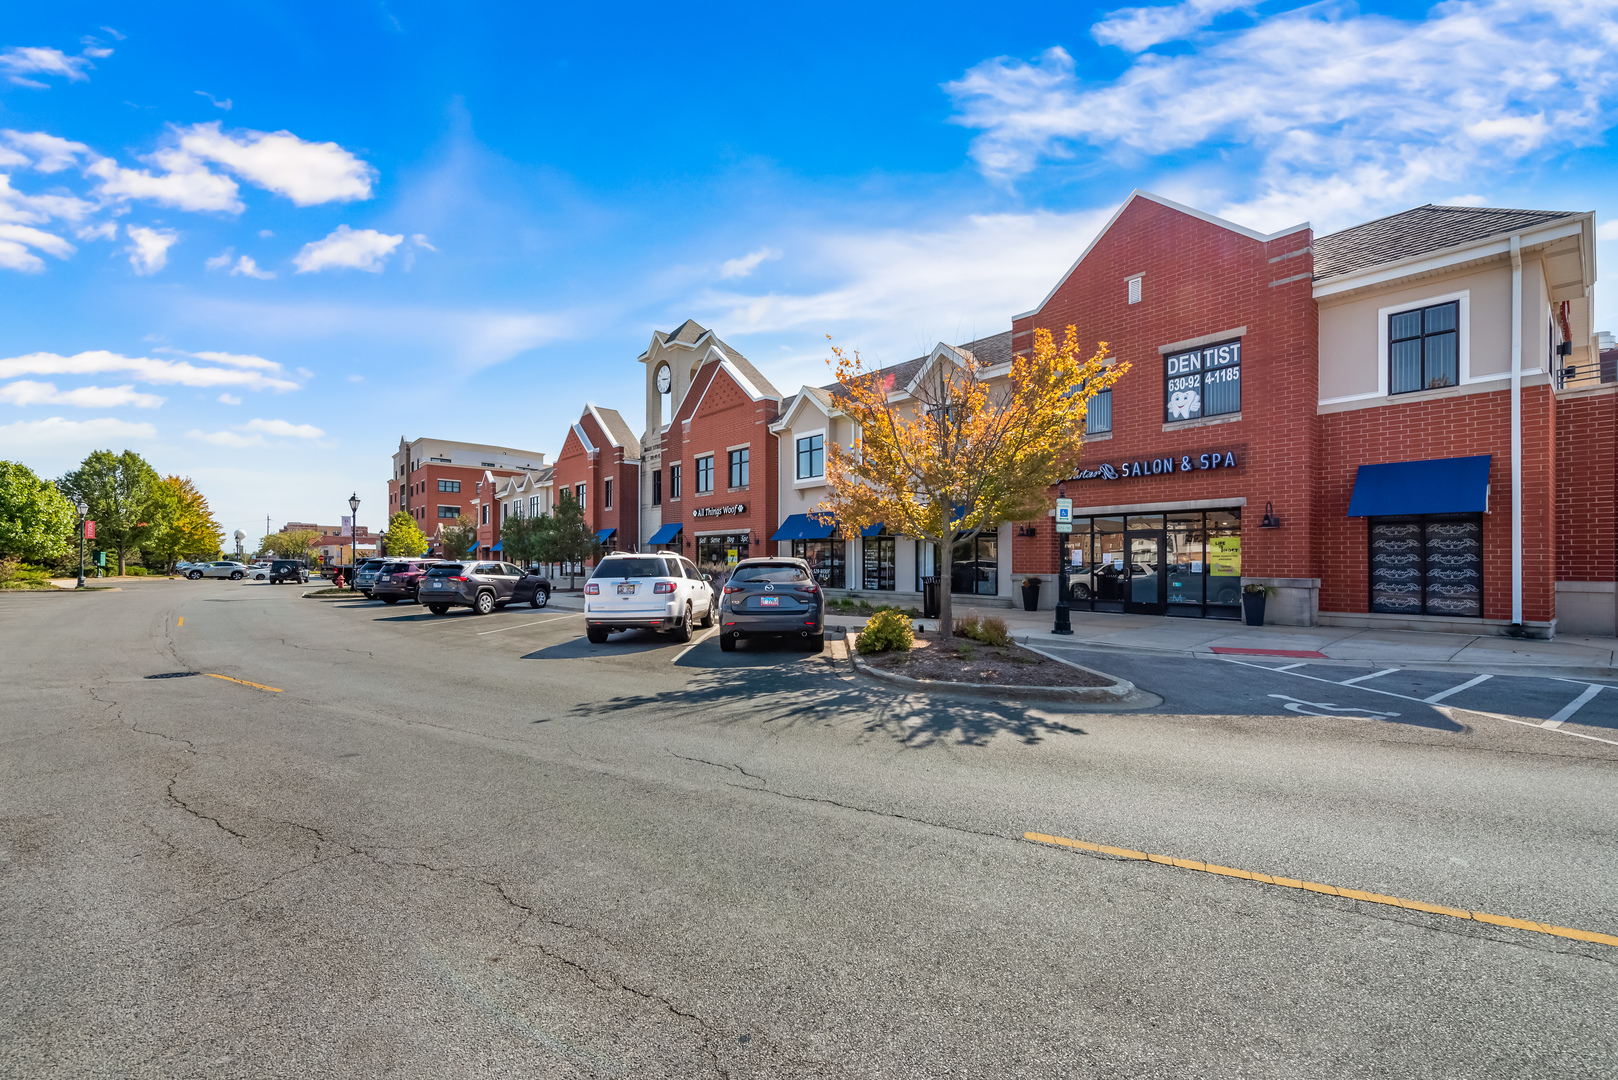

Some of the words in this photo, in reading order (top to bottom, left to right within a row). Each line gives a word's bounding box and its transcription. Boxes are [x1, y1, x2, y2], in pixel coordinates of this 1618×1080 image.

[1167, 343, 1241, 375] DENTIST
[1121, 457, 1174, 477] SALON
[1180, 455, 1192, 471] &
[1200, 451, 1236, 470] SPA
[705, 507, 722, 517] Things
[723, 505, 738, 516] Woof
[727, 536, 735, 544] Dog
